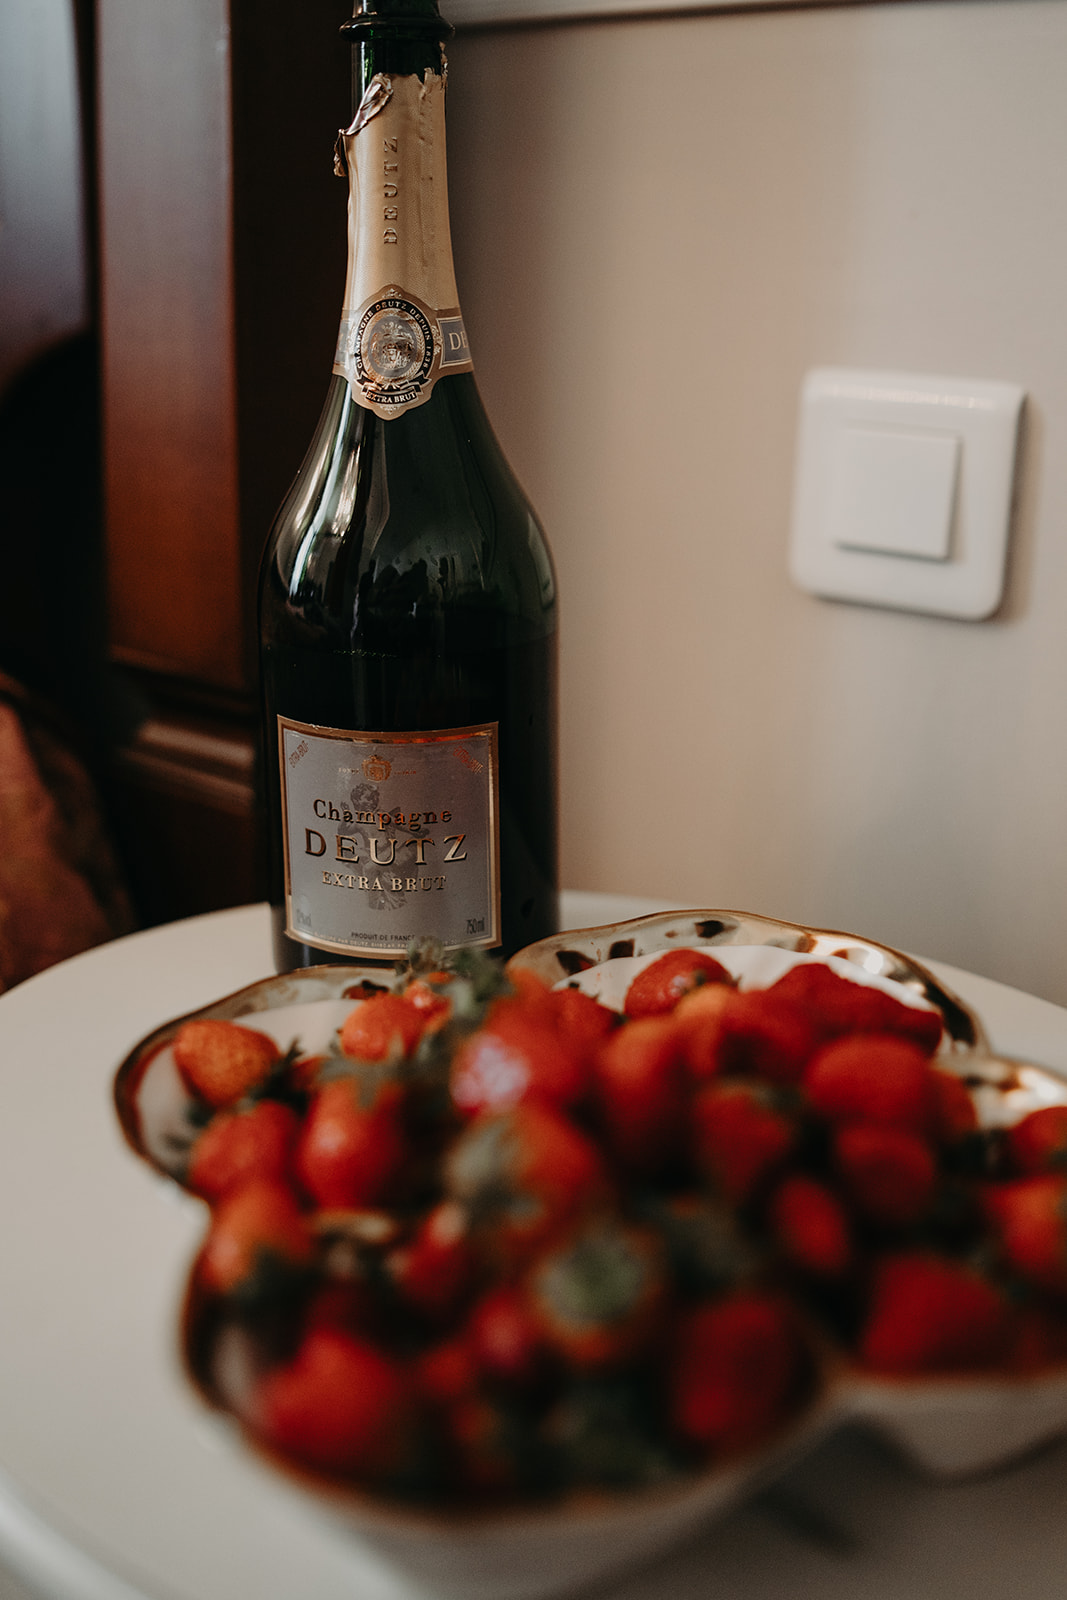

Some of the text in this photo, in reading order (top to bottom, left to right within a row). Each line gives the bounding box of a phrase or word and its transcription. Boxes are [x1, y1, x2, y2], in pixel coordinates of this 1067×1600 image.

[383, 136, 398, 245] DEUTZ
[375, 300, 407, 311] DEUTZ
[409, 308, 431, 341] DEPUIS
[366, 391, 417, 404] EXTRA BRUT
[313, 798, 452, 831] Champagne
[304, 827, 468, 866] DEUTZ
[321, 870, 447, 892] EXTRA BRUT
[351, 932, 378, 941] PRODUIT
